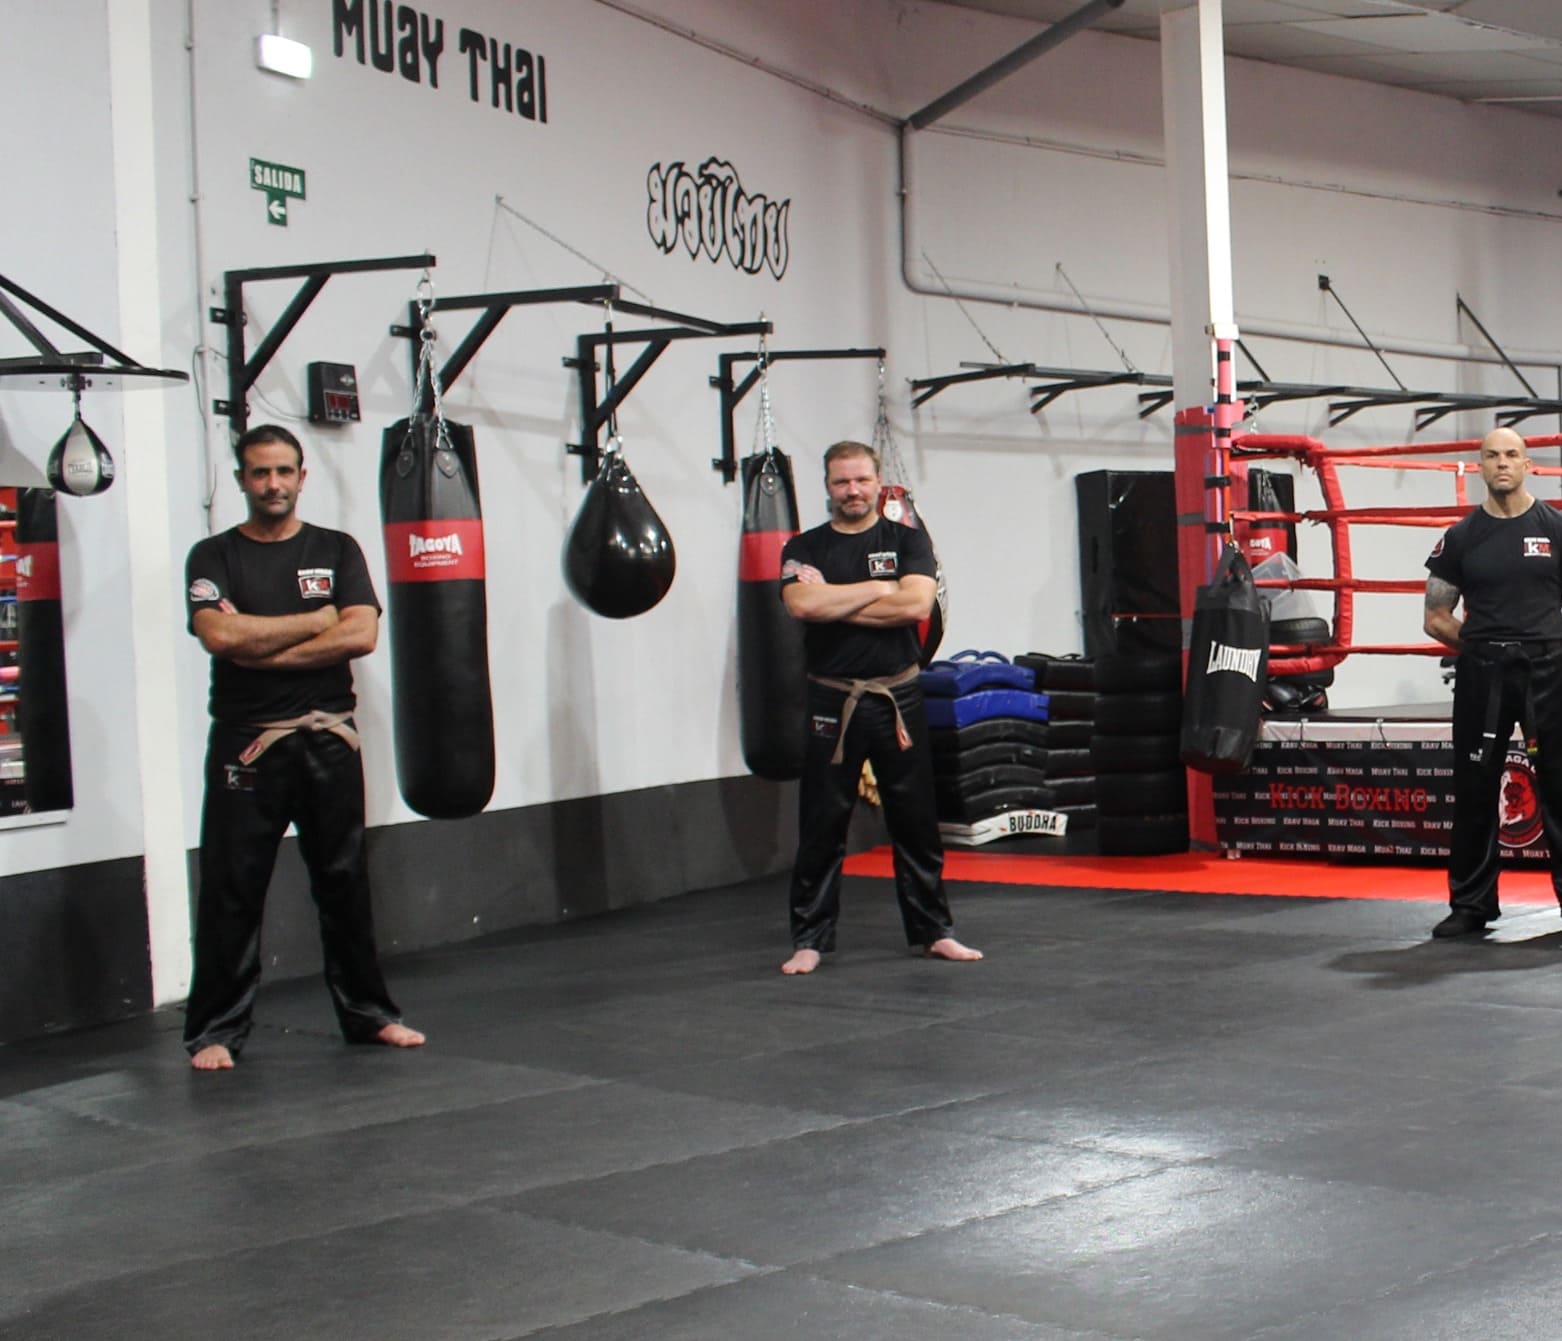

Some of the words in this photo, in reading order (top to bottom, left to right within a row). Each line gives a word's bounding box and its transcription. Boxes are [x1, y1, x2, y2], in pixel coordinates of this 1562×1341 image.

[330, 0, 445, 88] MUAY
[459, 28, 548, 123] THAI
[253, 164, 303, 194] SALIDA
[409, 533, 463, 557] TAGOYA
[1206, 640, 1262, 683] LAUNDRY
[1505, 754, 1530, 767] AGA
[1269, 783, 1326, 809] KICK
[1335, 784, 1429, 812] BOXING
[1009, 814, 1057, 832] BUDDHA
